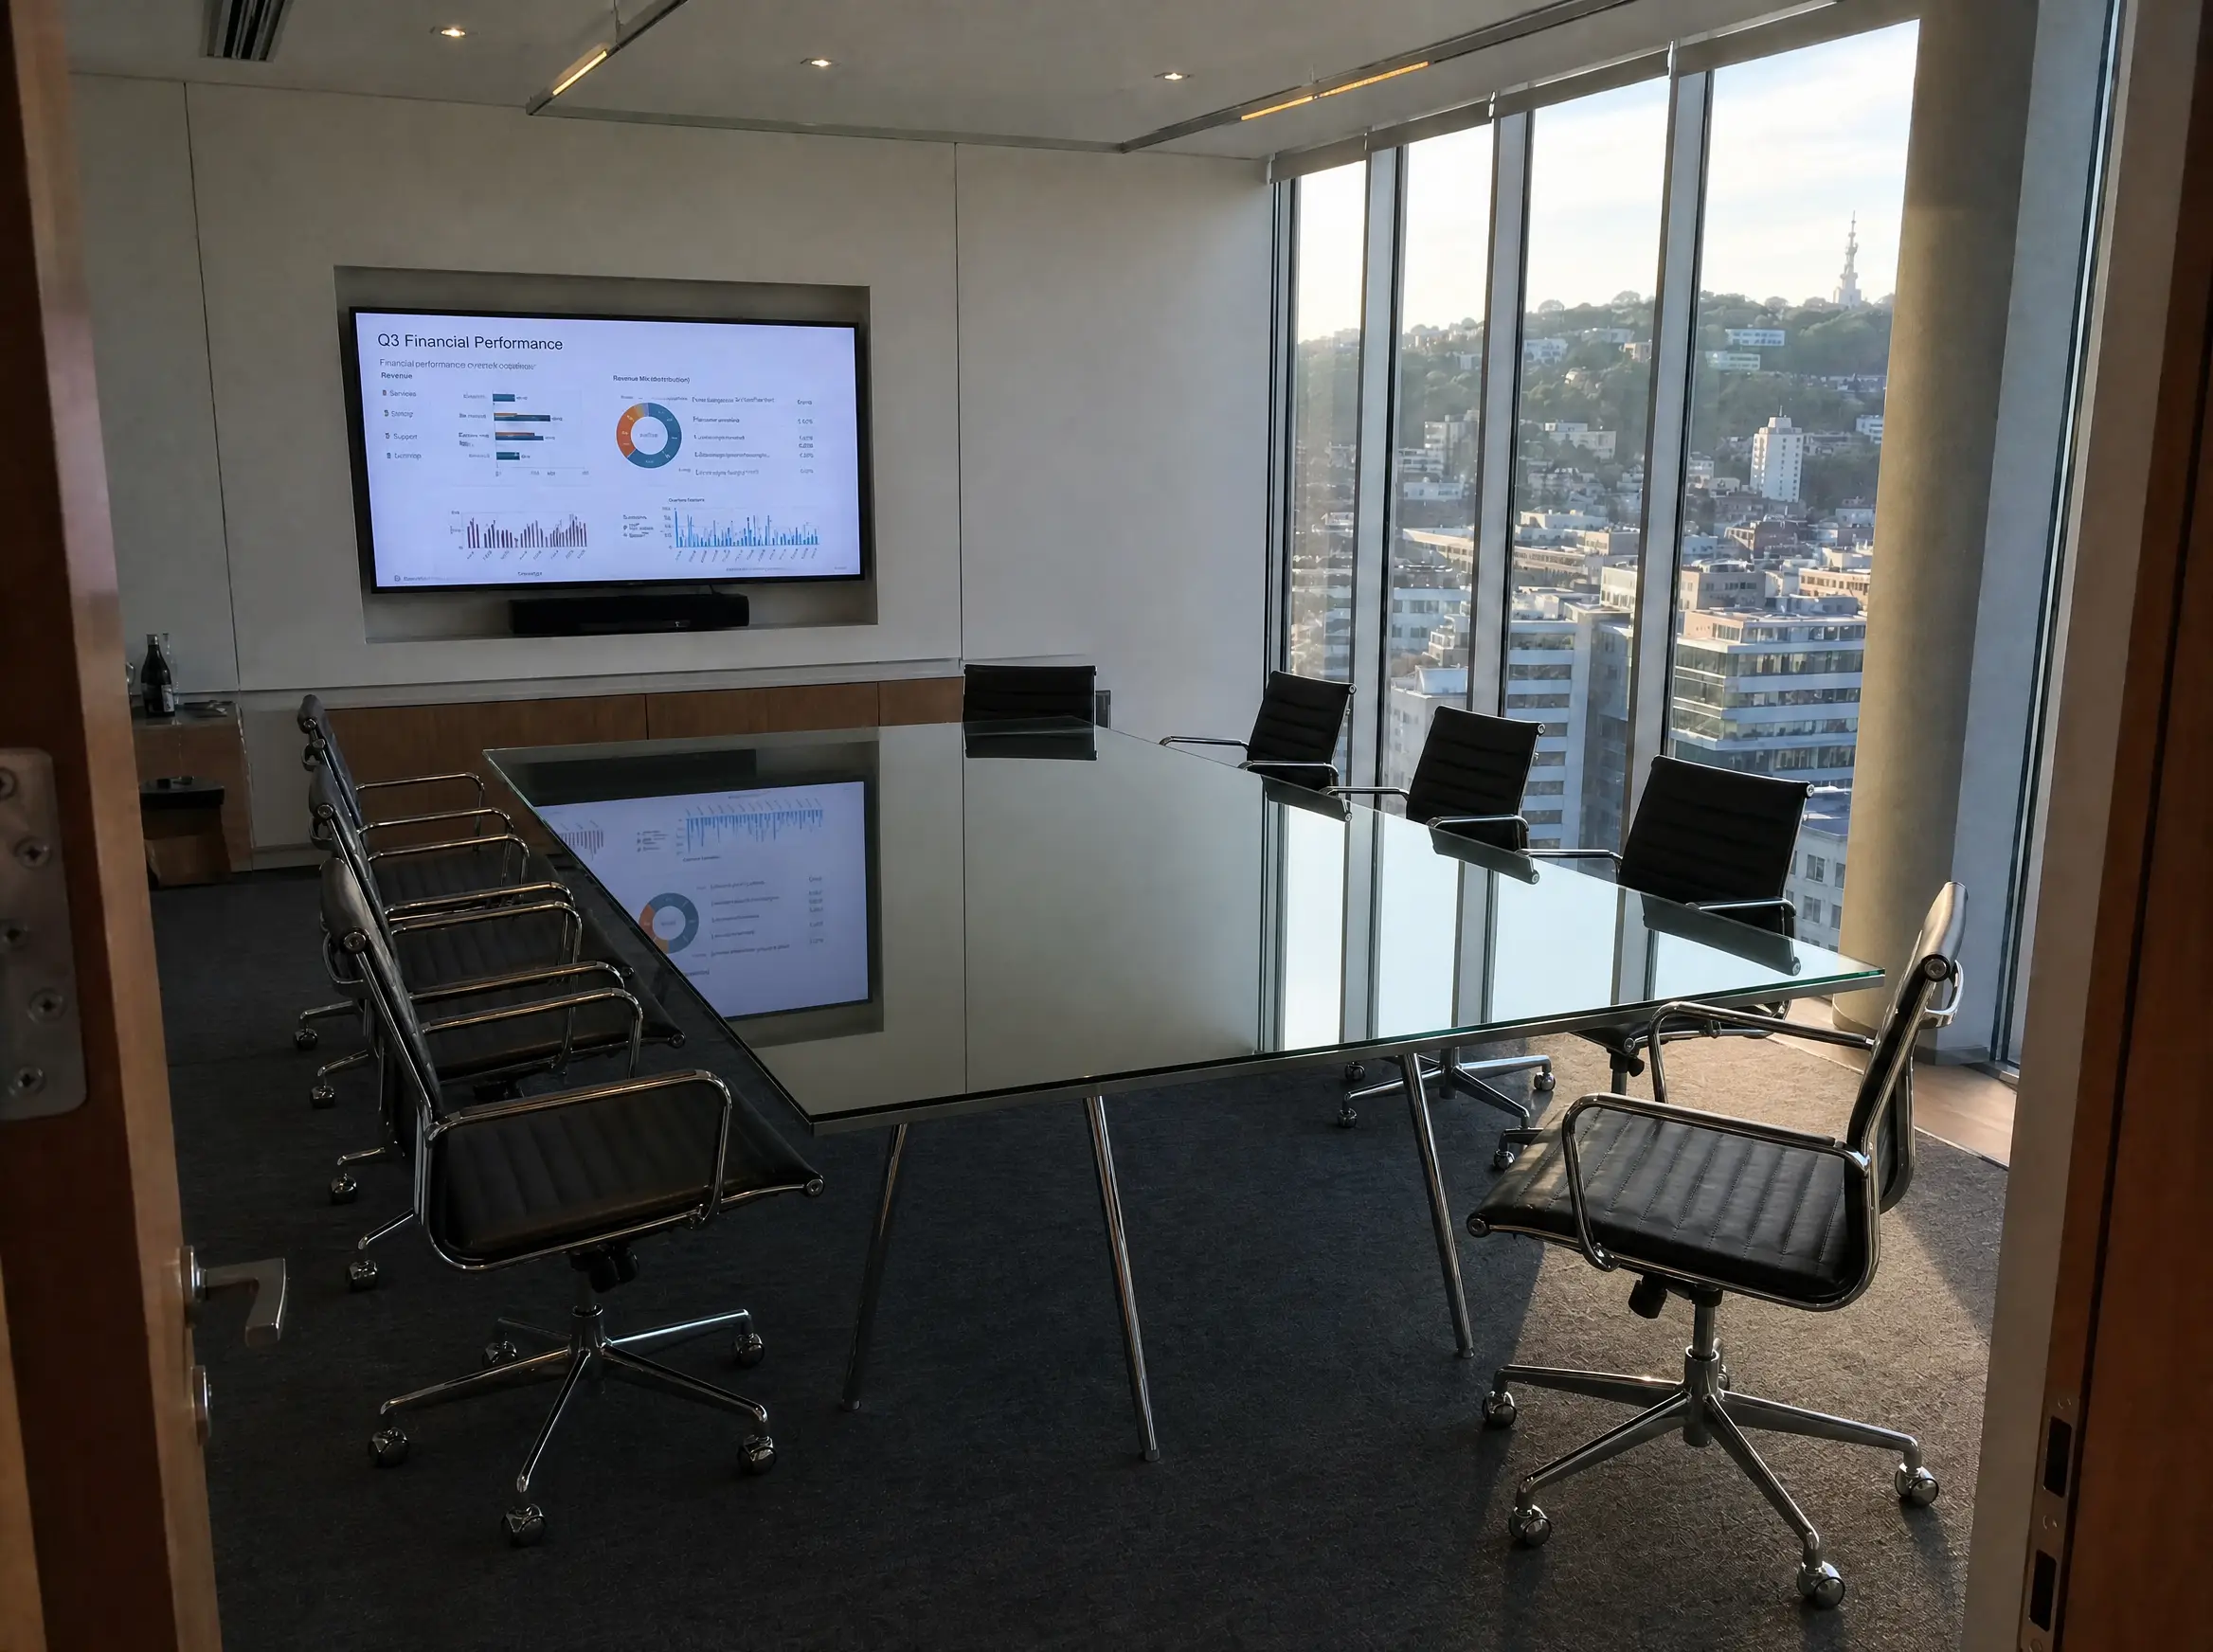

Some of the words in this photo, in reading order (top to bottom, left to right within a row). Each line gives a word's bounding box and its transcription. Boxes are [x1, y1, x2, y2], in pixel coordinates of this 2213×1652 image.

[377, 333, 400, 347] Q3
[405, 334, 470, 348] Financial
[475, 336, 563, 350] Performance
[379, 359, 415, 368] Financial
[415, 361, 466, 369] performance
[381, 371, 413, 380] Revenue
